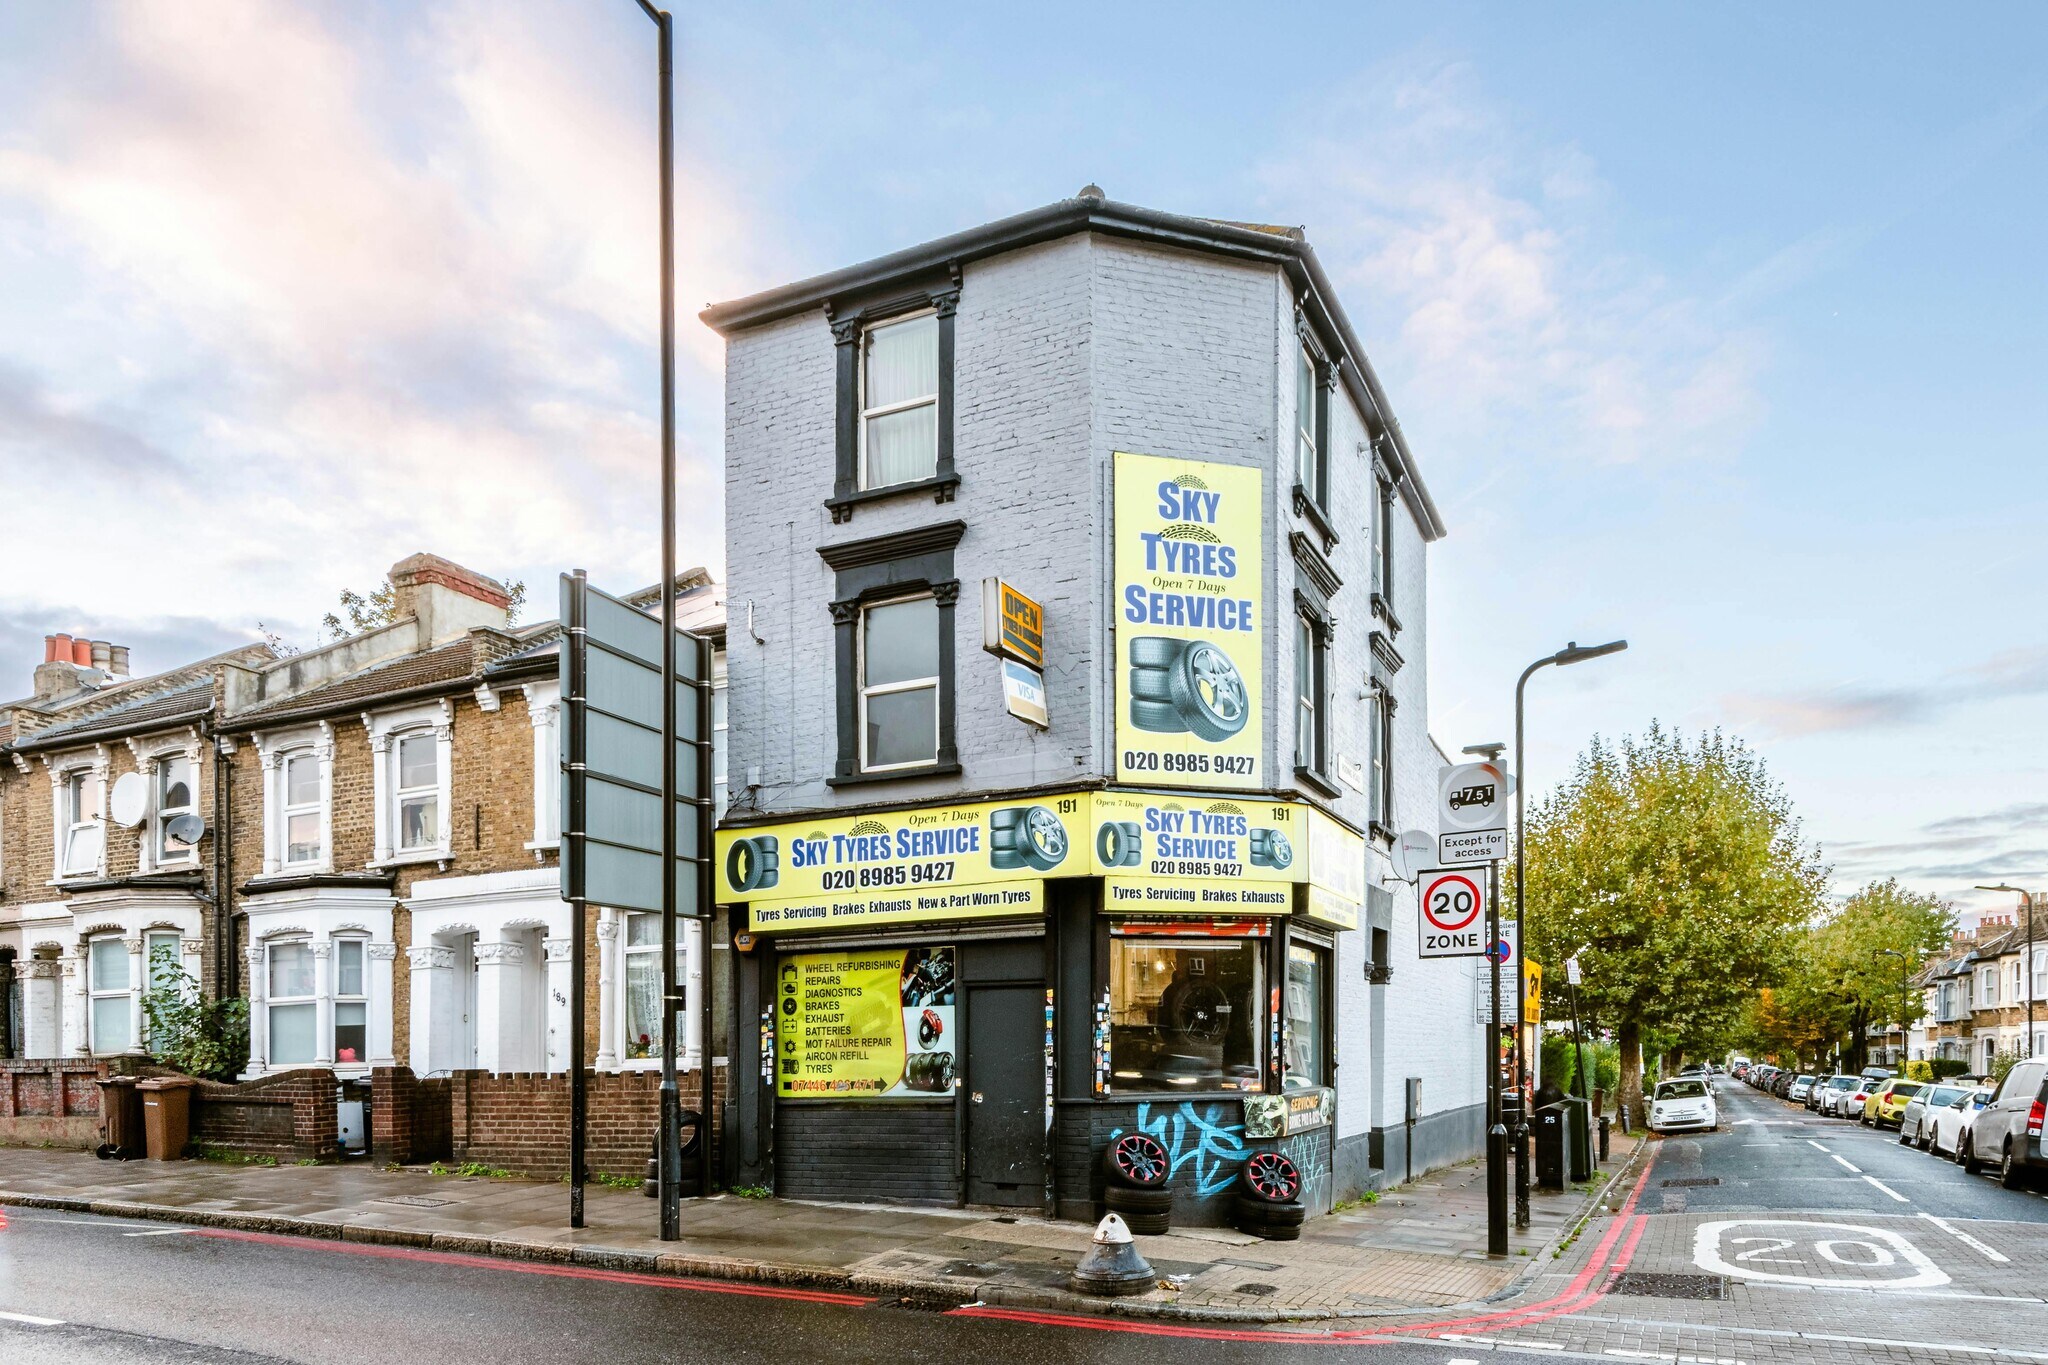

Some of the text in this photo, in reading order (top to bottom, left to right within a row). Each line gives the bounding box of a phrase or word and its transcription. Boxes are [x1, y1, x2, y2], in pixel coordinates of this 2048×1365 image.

[1152, 576, 1226, 593] Open 7 Days
[1006, 592, 1037, 631] OPEN
[1018, 682, 1034, 702] VISA
[1125, 751, 1254, 775] 020 8985 9427
[1057, 798, 1077, 814] 191
[1096, 799, 1116, 808] Open
[1124, 800, 1144, 809] Days
[909, 810, 980, 826] Open 7 Days
[1272, 808, 1290, 820] 191
[1445, 835, 1502, 847] Except for
[1455, 848, 1492, 858] access
[1151, 860, 1242, 876] 020 8985 9427
[822, 861, 954, 890] 020 8985 9427
[1113, 886, 1284, 904] Tyres Servicing Brakes Exhausts
[756, 890, 1030, 922] Tyres Servicing Brakes Exhausts New & Part Worn Tyres
[1434, 891, 1472, 914] 20
[1426, 934, 1478, 949] ZONE
[805, 960, 900, 974] WHEEL REFURBISHING
[806, 976, 841, 986] REPAIRS
[553, 988, 566, 1006] 189
[806, 988, 862, 998] DIAGNOSTICS
[806, 1001, 840, 1010] BRAKES
[806, 1014, 844, 1023] EXHAUST
[806, 1026, 851, 1036] BATTERIES
[806, 1037, 892, 1048] MOT FAILURE REPAIR
[806, 1050, 869, 1061] AIRCON REFILL
[806, 1064, 832, 1074] TYRES
[792, 1080, 826, 1091] 07446
[854, 1079, 875, 1091] 471
[1732, 1237, 1894, 1266] 20
